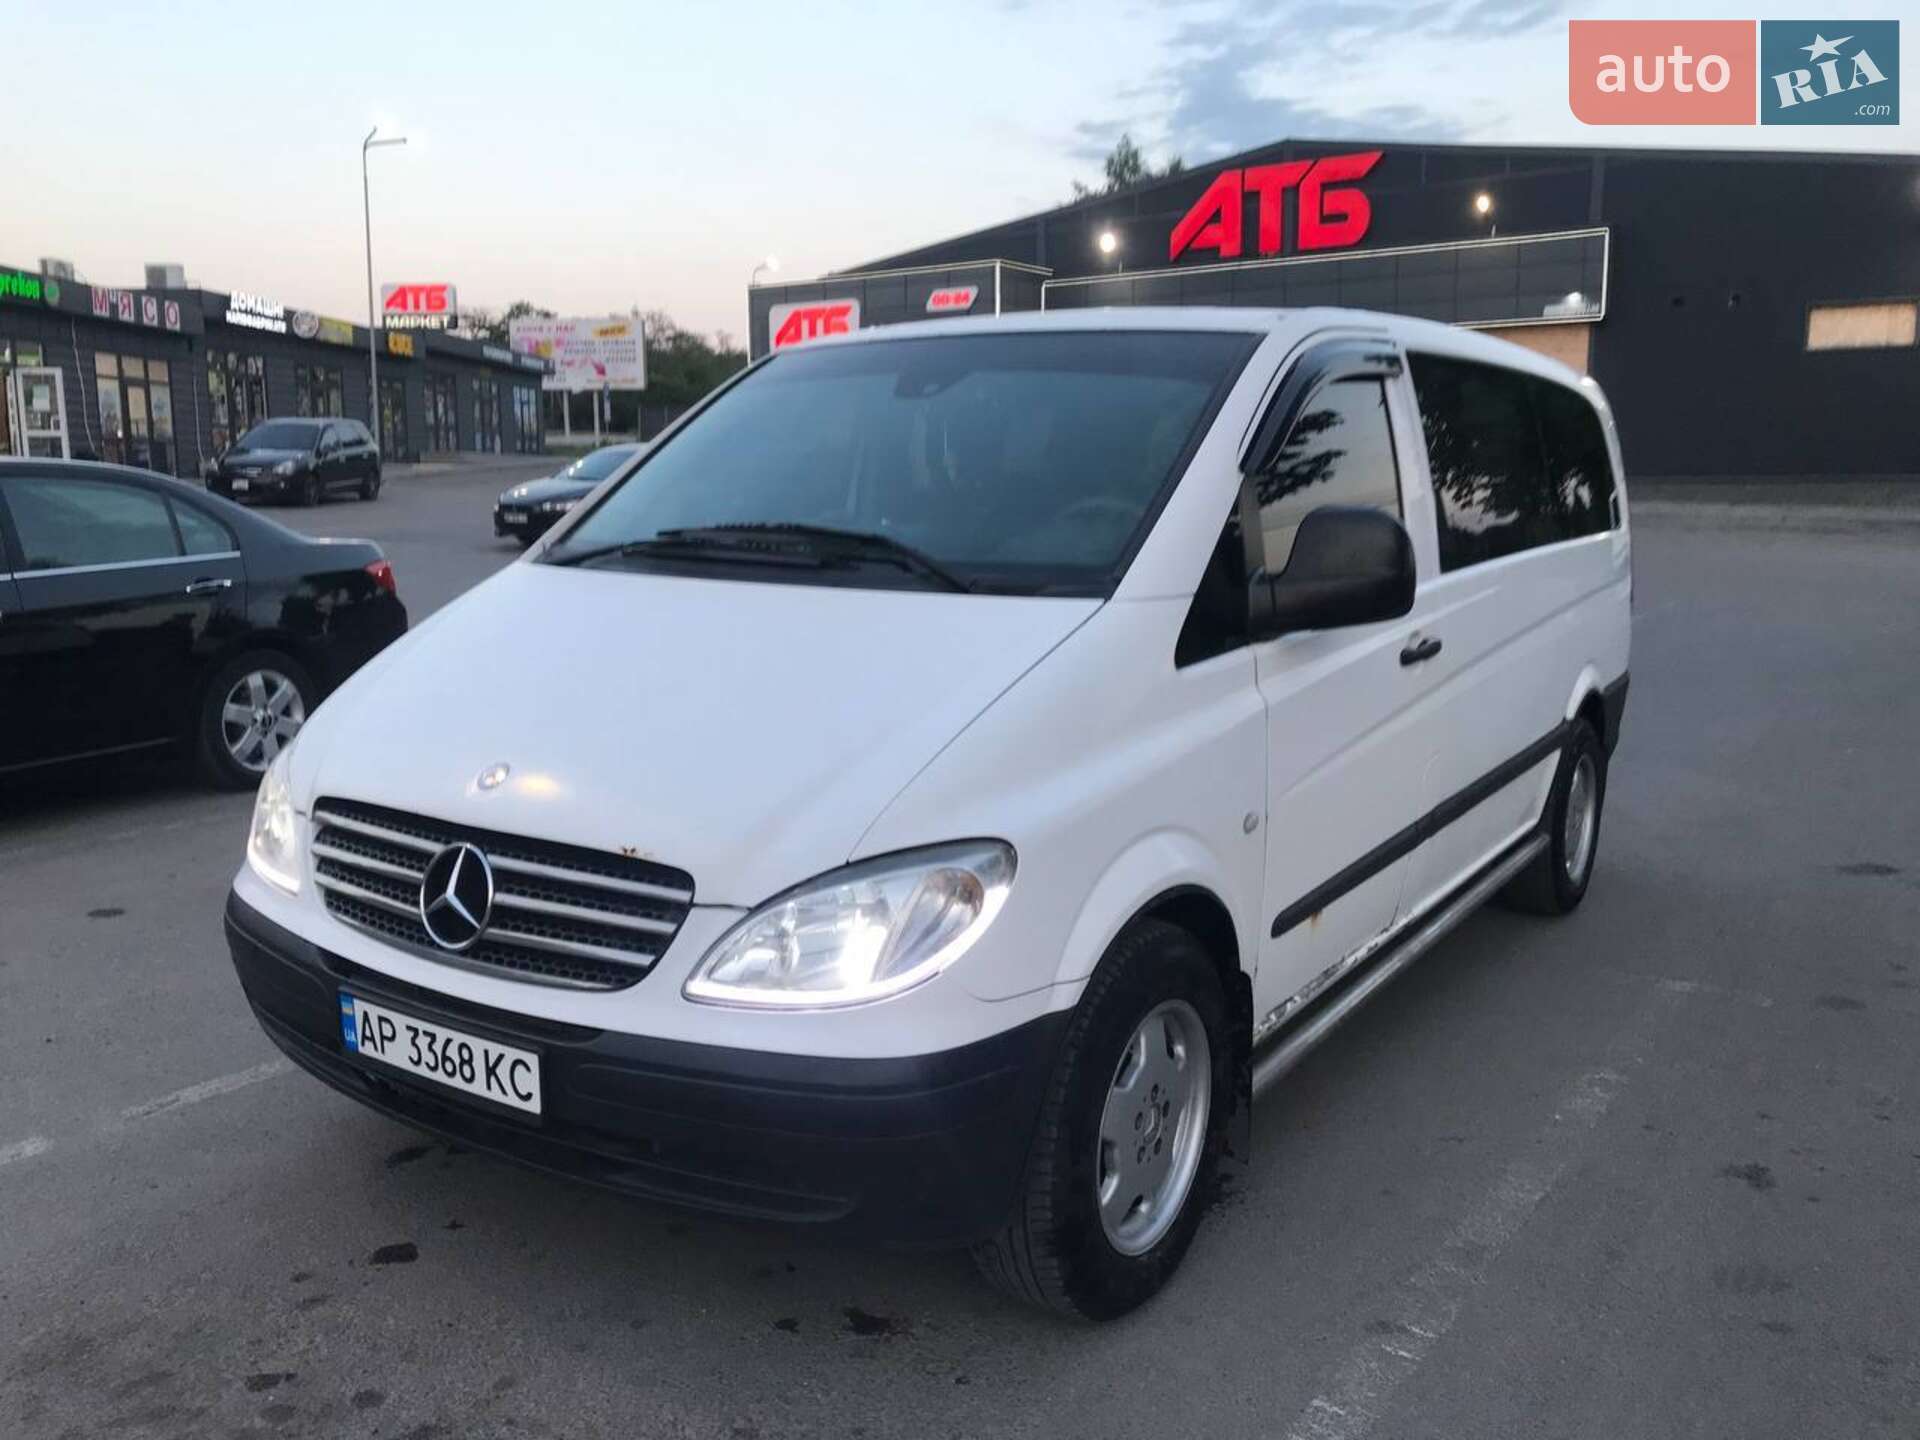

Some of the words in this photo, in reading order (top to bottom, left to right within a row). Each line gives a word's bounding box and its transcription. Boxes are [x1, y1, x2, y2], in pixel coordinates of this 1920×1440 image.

[1169, 150, 1384, 262] АТБ
[384, 285, 447, 312] АТБ
[385, 314, 448, 329] МАРКЕТ
[361, 1010, 396, 1055] AP
[406, 1024, 475, 1084] 3368
[484, 1048, 533, 1102] KC
